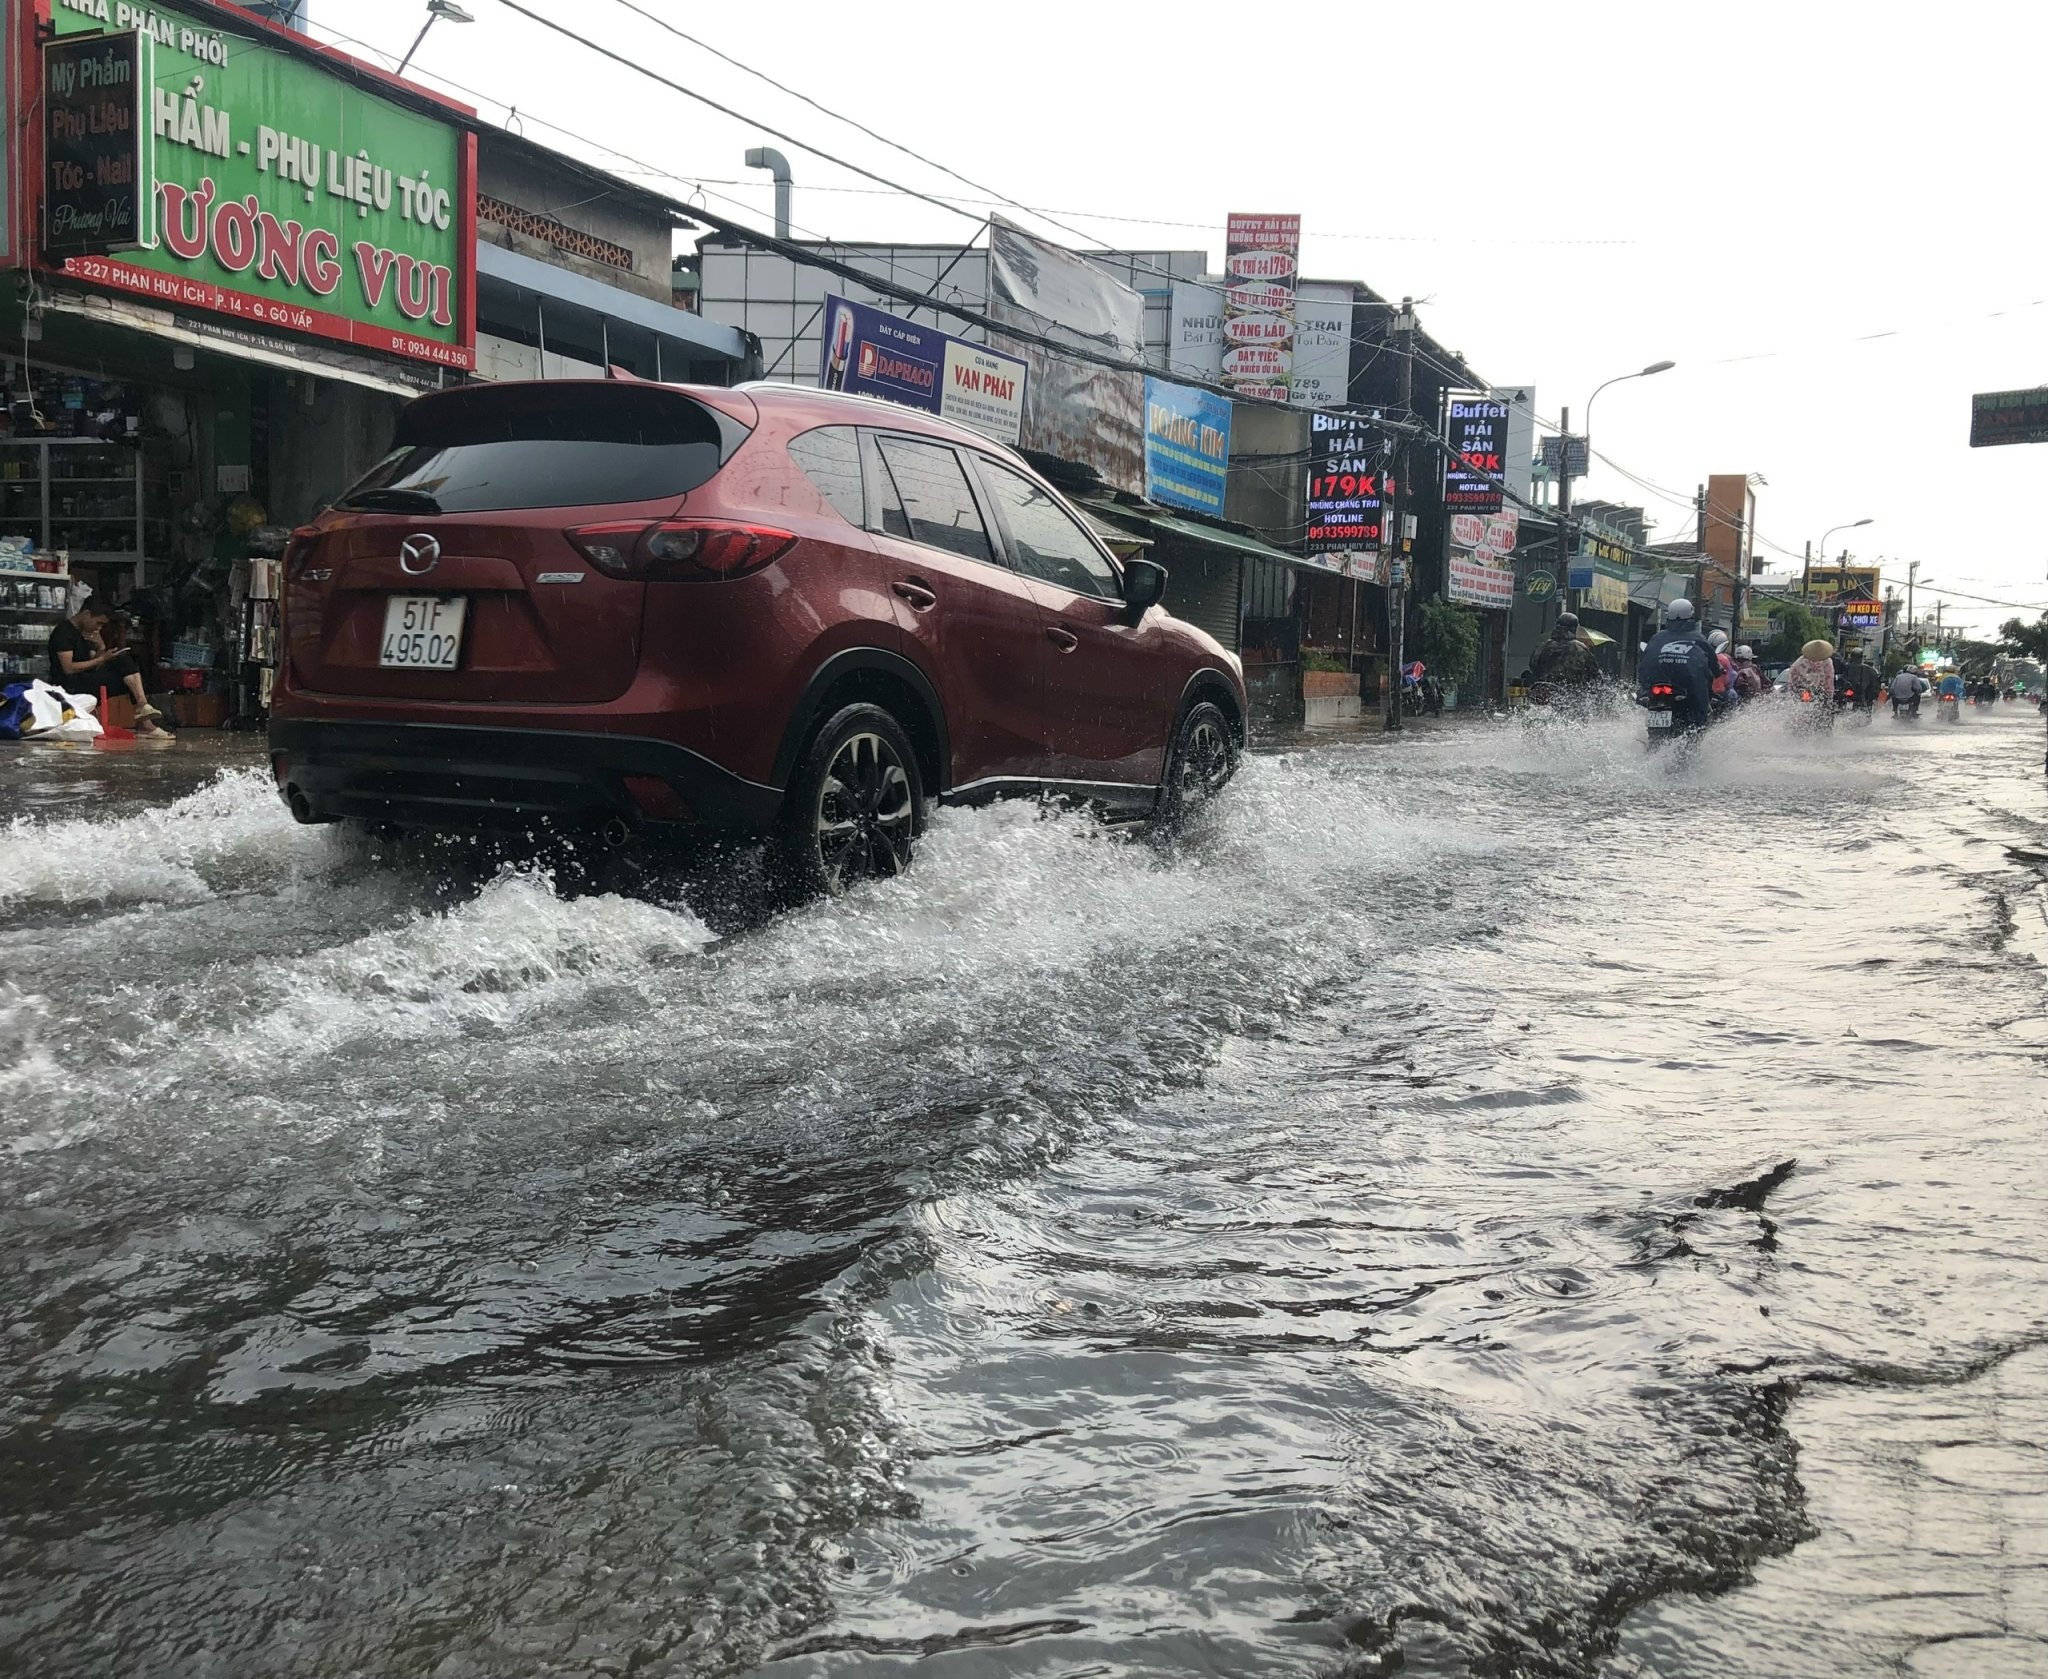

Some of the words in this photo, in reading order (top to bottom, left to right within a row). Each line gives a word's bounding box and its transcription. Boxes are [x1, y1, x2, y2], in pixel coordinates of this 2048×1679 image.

[116, 2, 174, 47] PHÂN
[181, 28, 227, 67] PHỐI
[52, 63, 76, 97] Mỹ
[80, 48, 130, 88] Phẩm
[258, 125, 320, 202] PHỤ
[327, 149, 391, 217] LIỆU
[397, 170, 450, 230] TÓC
[1230, 219, 1262, 229] BUFFET
[154, 177, 342, 294] ƯƠNG
[353, 242, 452, 325] VUI
[84, 261, 108, 280] 227
[113, 268, 149, 290] PHAN
[154, 279, 179, 296] HUY
[184, 281, 205, 303] ÍCH
[230, 297, 241, 311] 14
[270, 305, 288, 322] GÒ
[291, 309, 312, 328] VẤP
[392, 336, 406, 351] ĐT:
[408, 341, 430, 357] 0934
[432, 347, 449, 361] 444
[451, 352, 468, 366] 350
[878, 356, 933, 388] DAPHACO
[954, 364, 980, 393] VẠN
[983, 375, 1015, 401] PHÁT
[1294, 379, 1320, 389] 789
[1273, 386, 1286, 400] 789
[1452, 402, 1507, 418] Buffet
[1464, 420, 1492, 436] HẢI
[1200, 424, 1225, 460] KIM
[1329, 433, 1363, 452] HẢI
[1461, 436, 1493, 452] SẢN
[1326, 453, 1366, 473] SẢN
[1314, 475, 1376, 497] 179K
[1459, 483, 1490, 491] HOTLINE
[1362, 500, 1379, 508] TRAI
[1324, 514, 1364, 523] HOTLINE
[1310, 525, 1378, 539] 0933599789
[1310, 543, 1325, 551] 233
[1327, 542, 1347, 551] PHAN
[1348, 542, 1363, 550] HUY
[403, 600, 444, 631] 51F
[382, 633, 457, 664] 495.02
